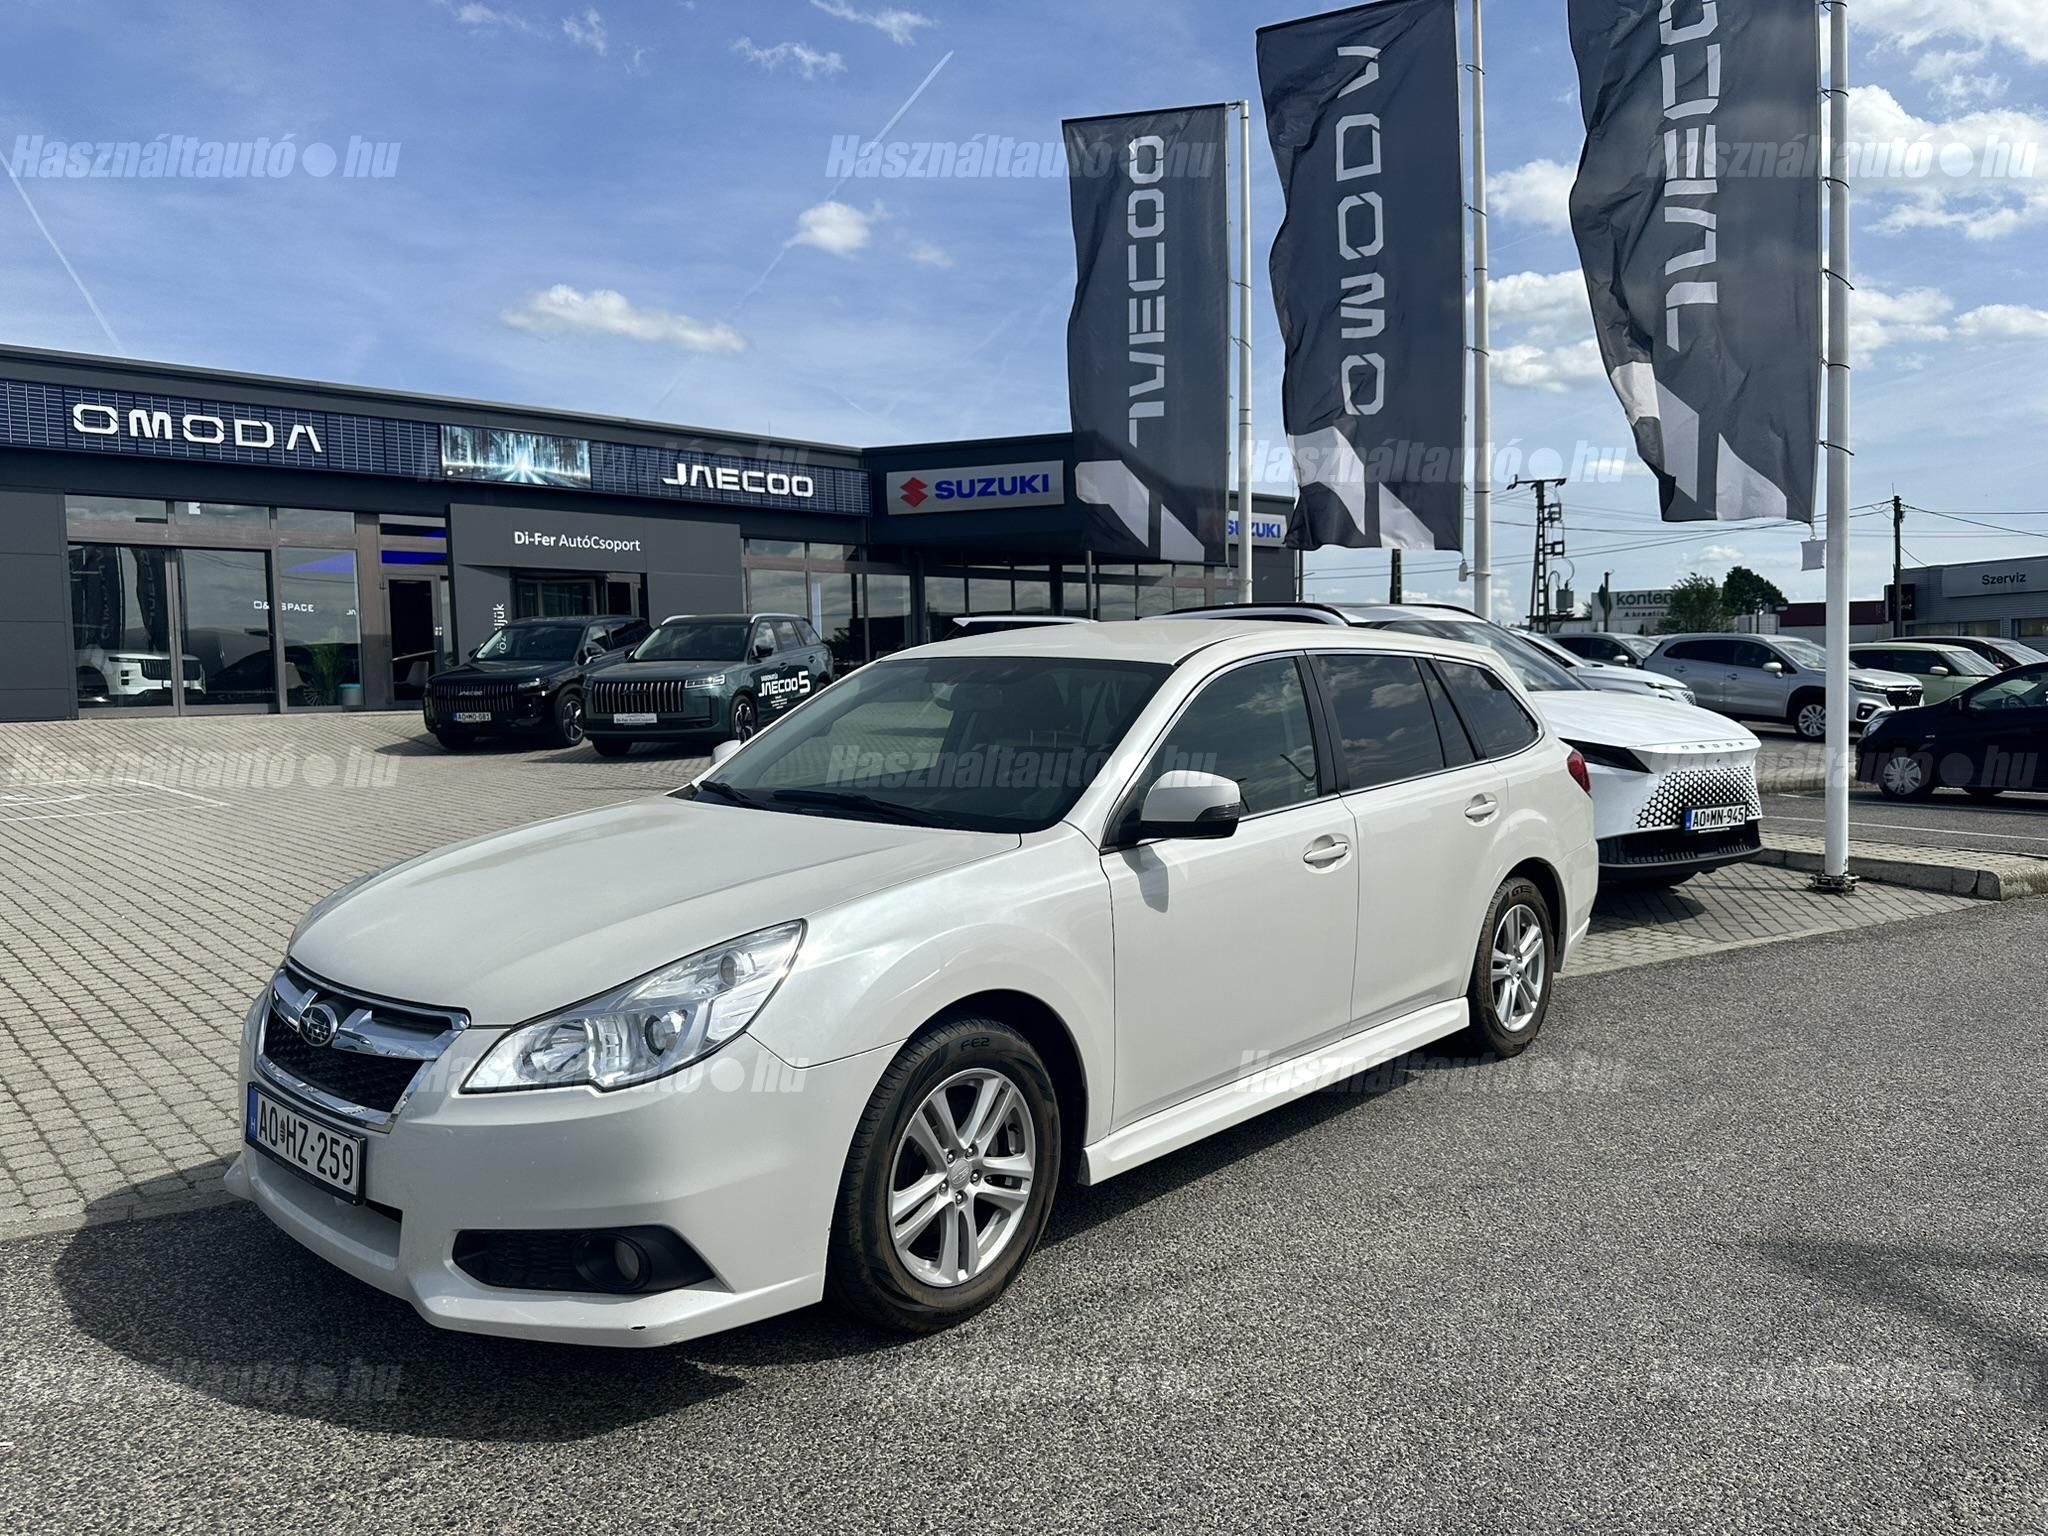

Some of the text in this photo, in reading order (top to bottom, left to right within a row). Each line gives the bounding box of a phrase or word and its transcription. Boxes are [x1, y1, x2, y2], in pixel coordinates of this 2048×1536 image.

[72, 403, 323, 453] OMODA
[662, 463, 814, 498] JAECOO
[934, 474, 1050, 500] SUZUKI
[1227, 520, 1281, 538] SUKI
[514, 531, 641, 552] Di-Fer AutóCsoport
[1981, 572, 2027, 586] Szerviz
[798, 670, 811, 694] 5
